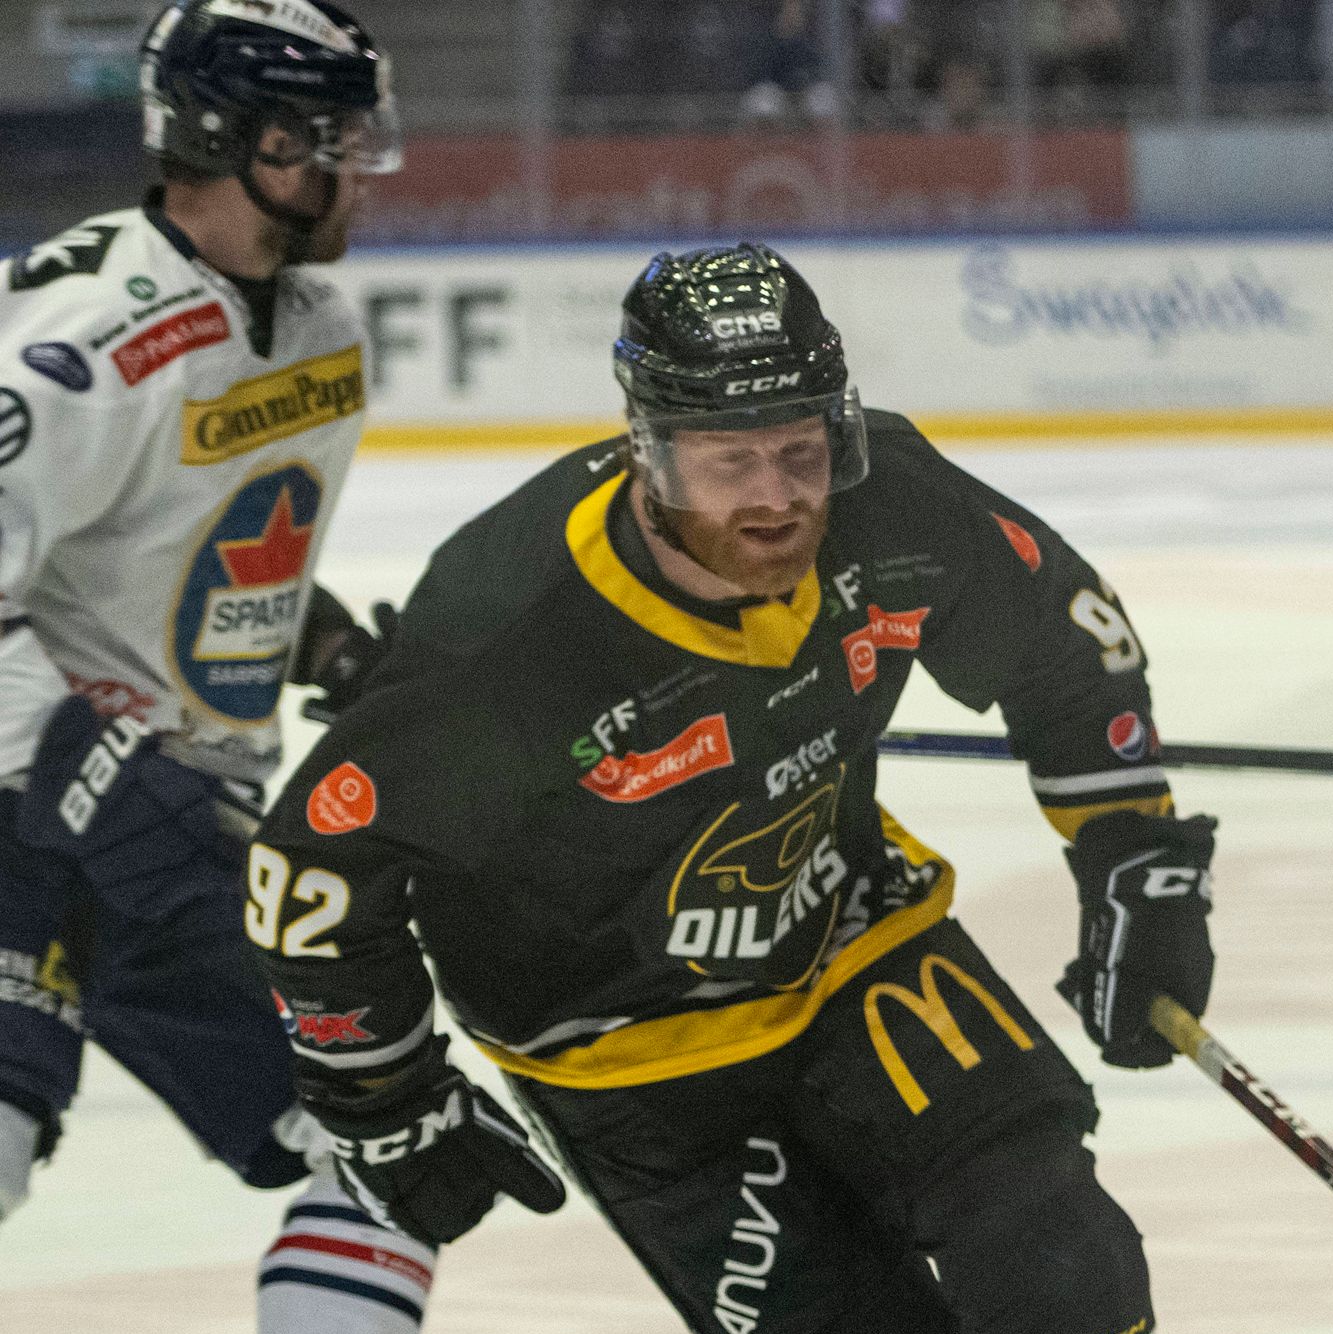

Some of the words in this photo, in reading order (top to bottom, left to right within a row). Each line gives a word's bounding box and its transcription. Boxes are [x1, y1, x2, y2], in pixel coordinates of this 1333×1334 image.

[712, 311, 782, 338] CMS
[725, 371, 800, 396] CCM
[1068, 587, 1150, 676] 9
[570, 699, 637, 767] SFF
[244, 841, 351, 959] 92
